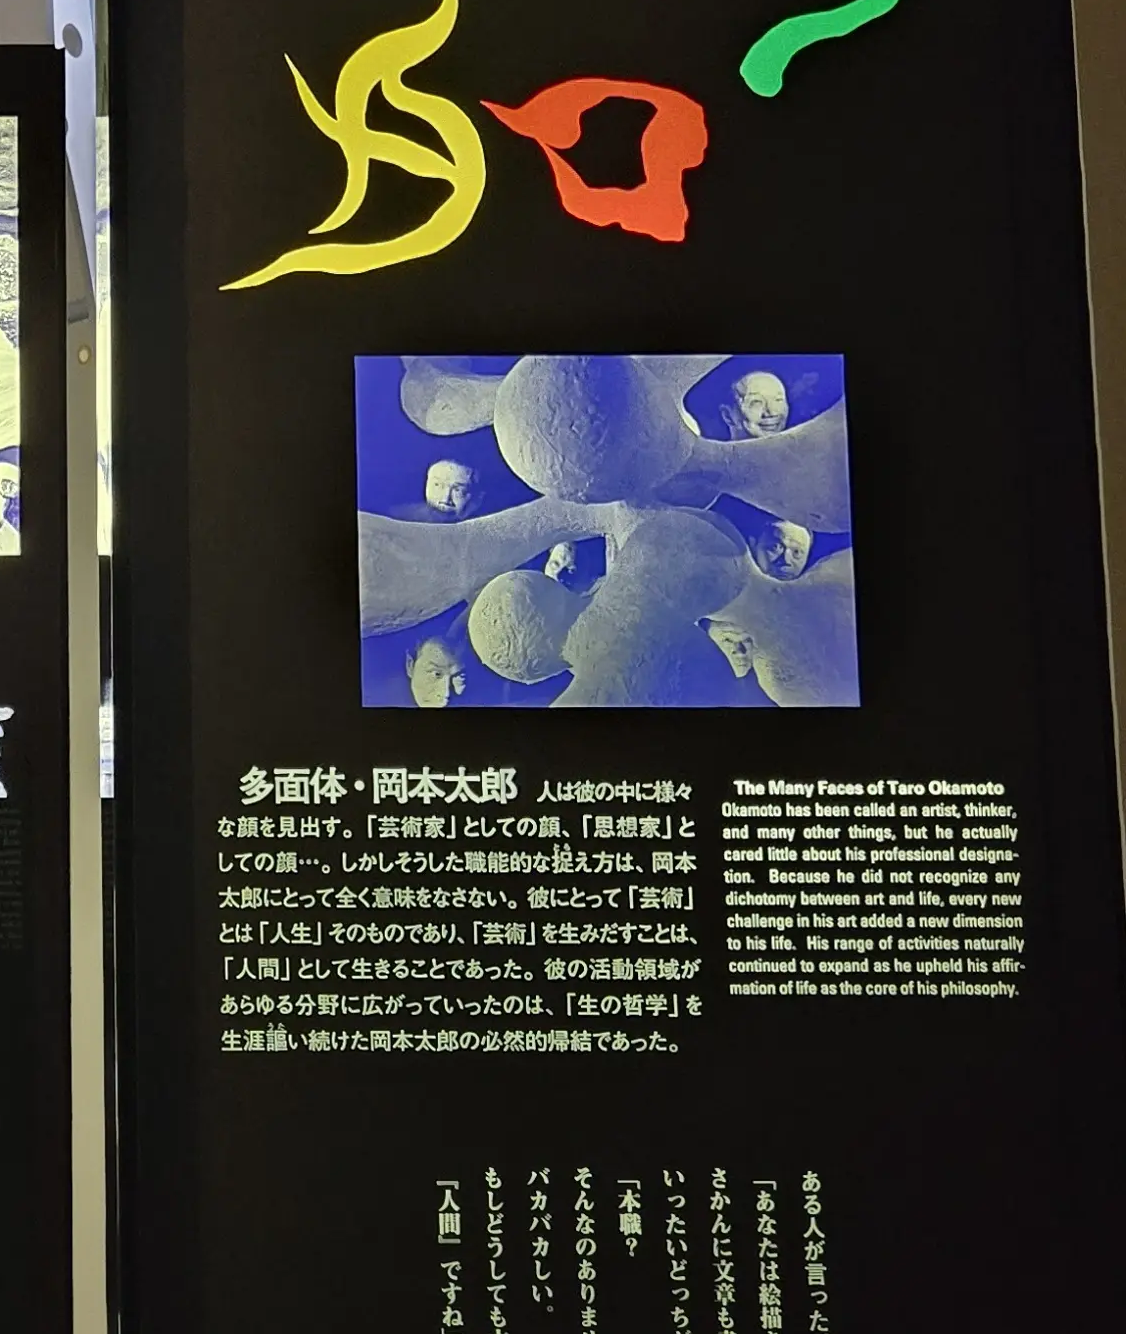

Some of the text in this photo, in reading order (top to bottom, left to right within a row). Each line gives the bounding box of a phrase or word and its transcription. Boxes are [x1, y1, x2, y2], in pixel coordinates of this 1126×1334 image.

[239, 766, 692, 805] 多面体・岡本太郎 人は彼の中に様々
[733, 779, 1005, 798] The Many Faces of Taro Okamoto
[721, 802, 1017, 819] Okamoto has been called an artist, thinker,
[722, 824, 1018, 842] and many other things, but he actually
[723, 847, 1019, 864] cared little about his professional designa-
[723, 868, 1021, 887] tion. Because he did not recognize any
[725, 891, 1022, 909] dichotomy between art and life, every new
[727, 913, 1023, 931] challenge in his art added a new dimension
[726, 935, 1025, 953] to his life. His range of activities naturally
[728, 958, 1026, 976] continued to expand as he upheld his affir-
[729, 980, 1019, 998] mation of life as the core of his philosophy.
